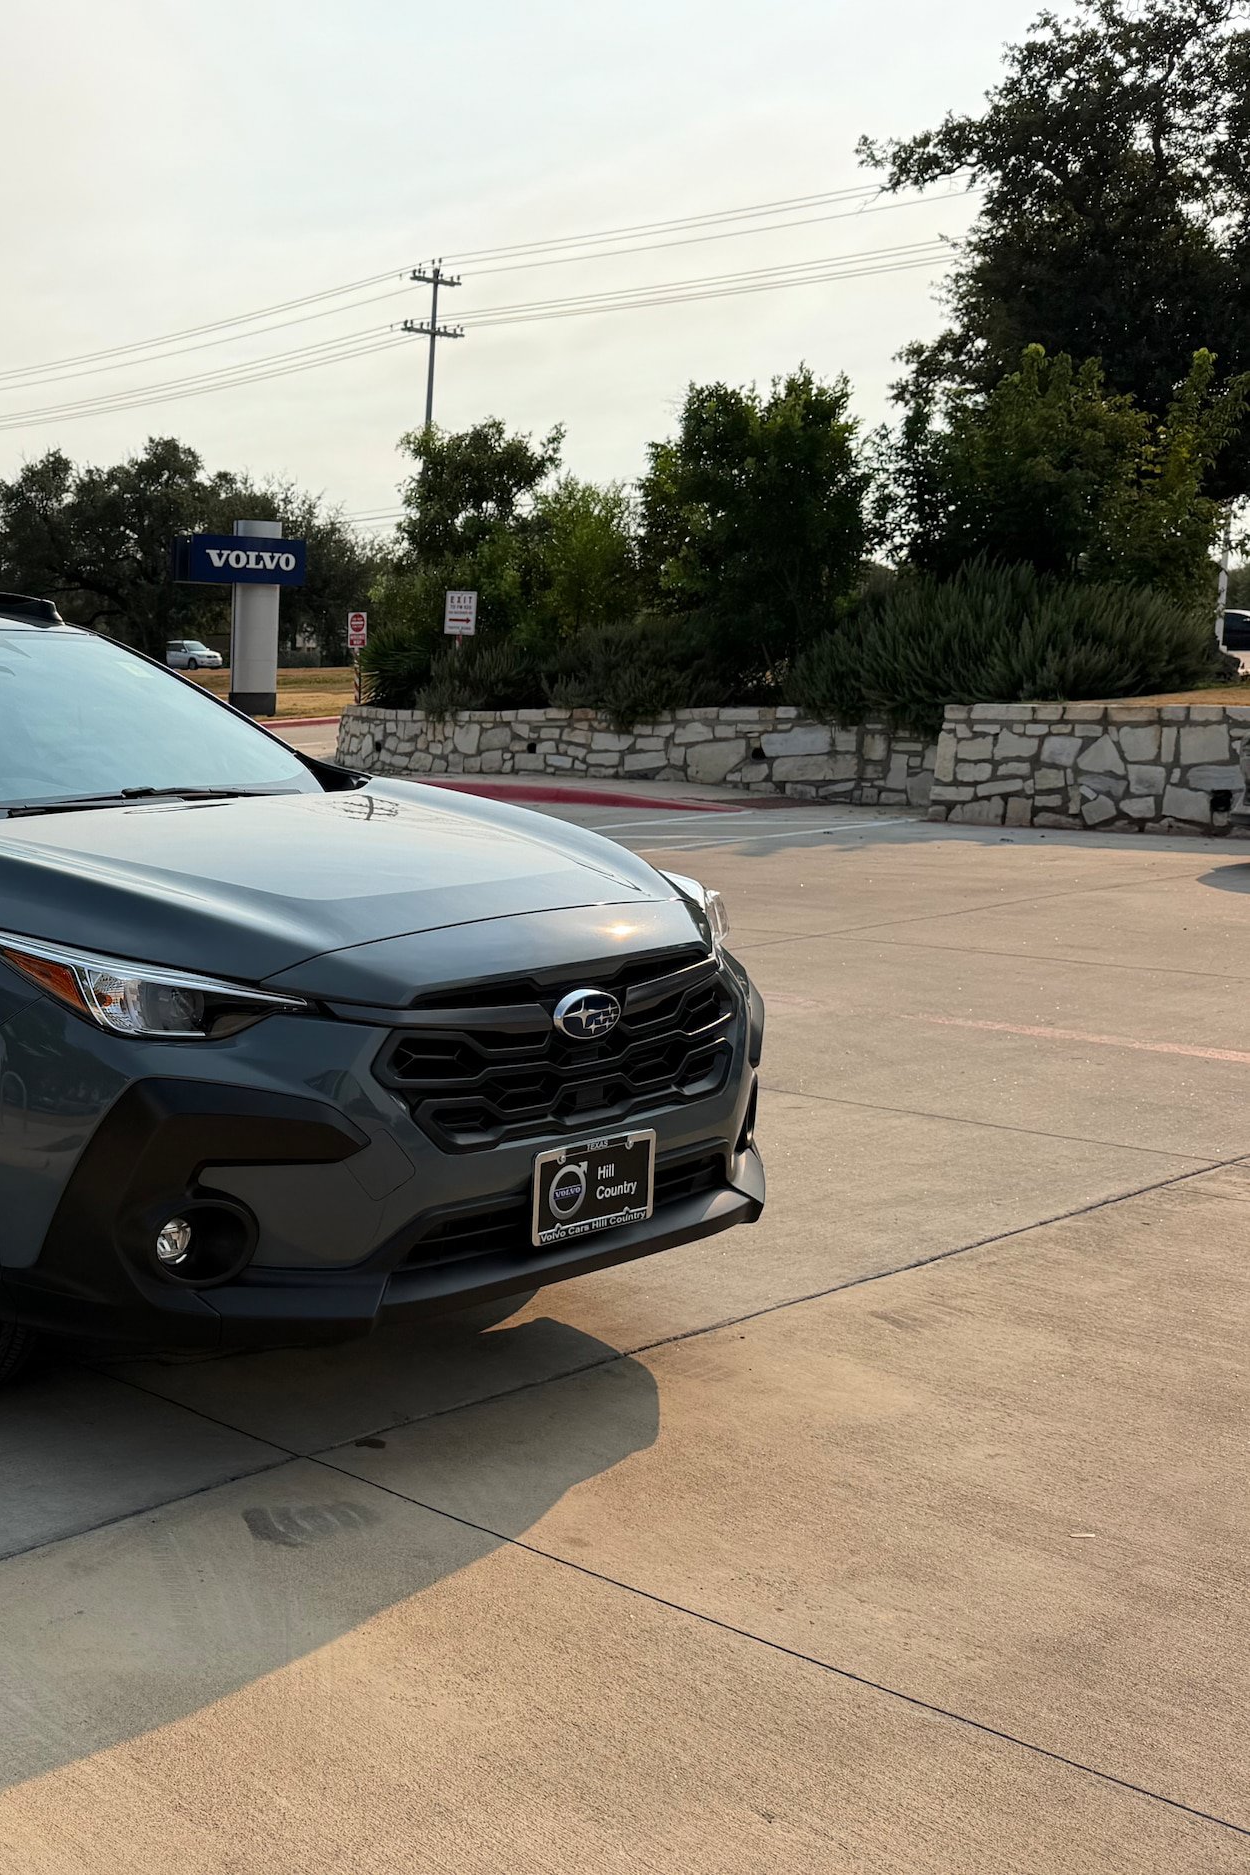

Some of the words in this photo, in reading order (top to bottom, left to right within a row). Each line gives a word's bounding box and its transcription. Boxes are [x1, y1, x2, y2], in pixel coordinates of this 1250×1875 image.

[205, 549, 296, 571] VOLVO
[450, 596, 472, 604] EXIT
[587, 1140, 609, 1151] TEXAS
[597, 1163, 615, 1180] Hill
[555, 1186, 581, 1199] VOLVO
[596, 1181, 638, 1200] Country
[540, 1230, 566, 1243] Volvo
[568, 1225, 590, 1236] Cars
[592, 1218, 607, 1229] Hill
[609, 1210, 646, 1225] Country
